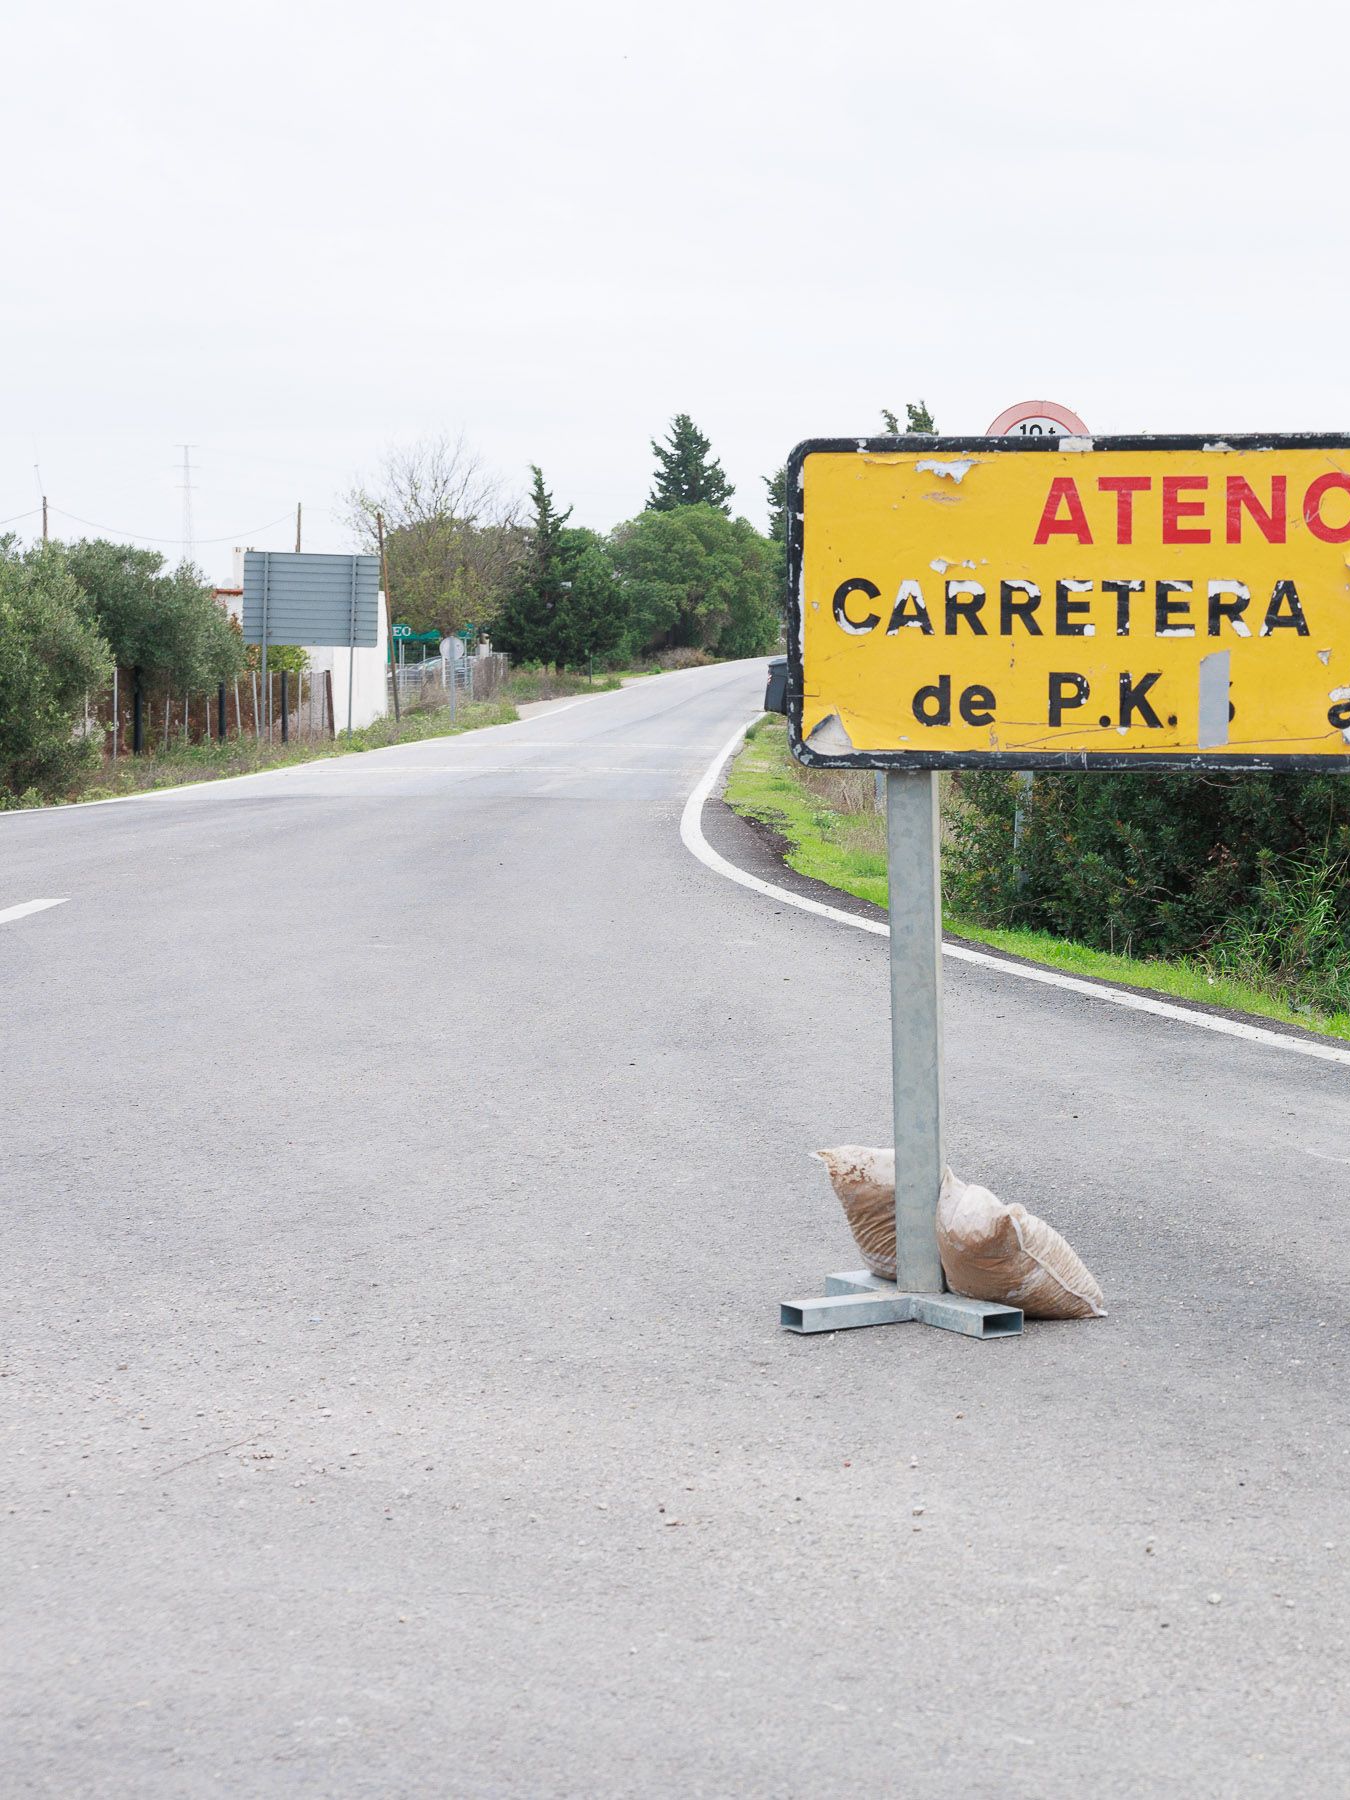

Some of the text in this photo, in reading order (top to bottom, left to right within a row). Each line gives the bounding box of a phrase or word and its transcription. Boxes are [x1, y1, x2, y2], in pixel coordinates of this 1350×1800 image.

[832, 578, 1310, 637] CARRETERA
[912, 674, 997, 727] de
[1048, 672, 1179, 728] P.K.
